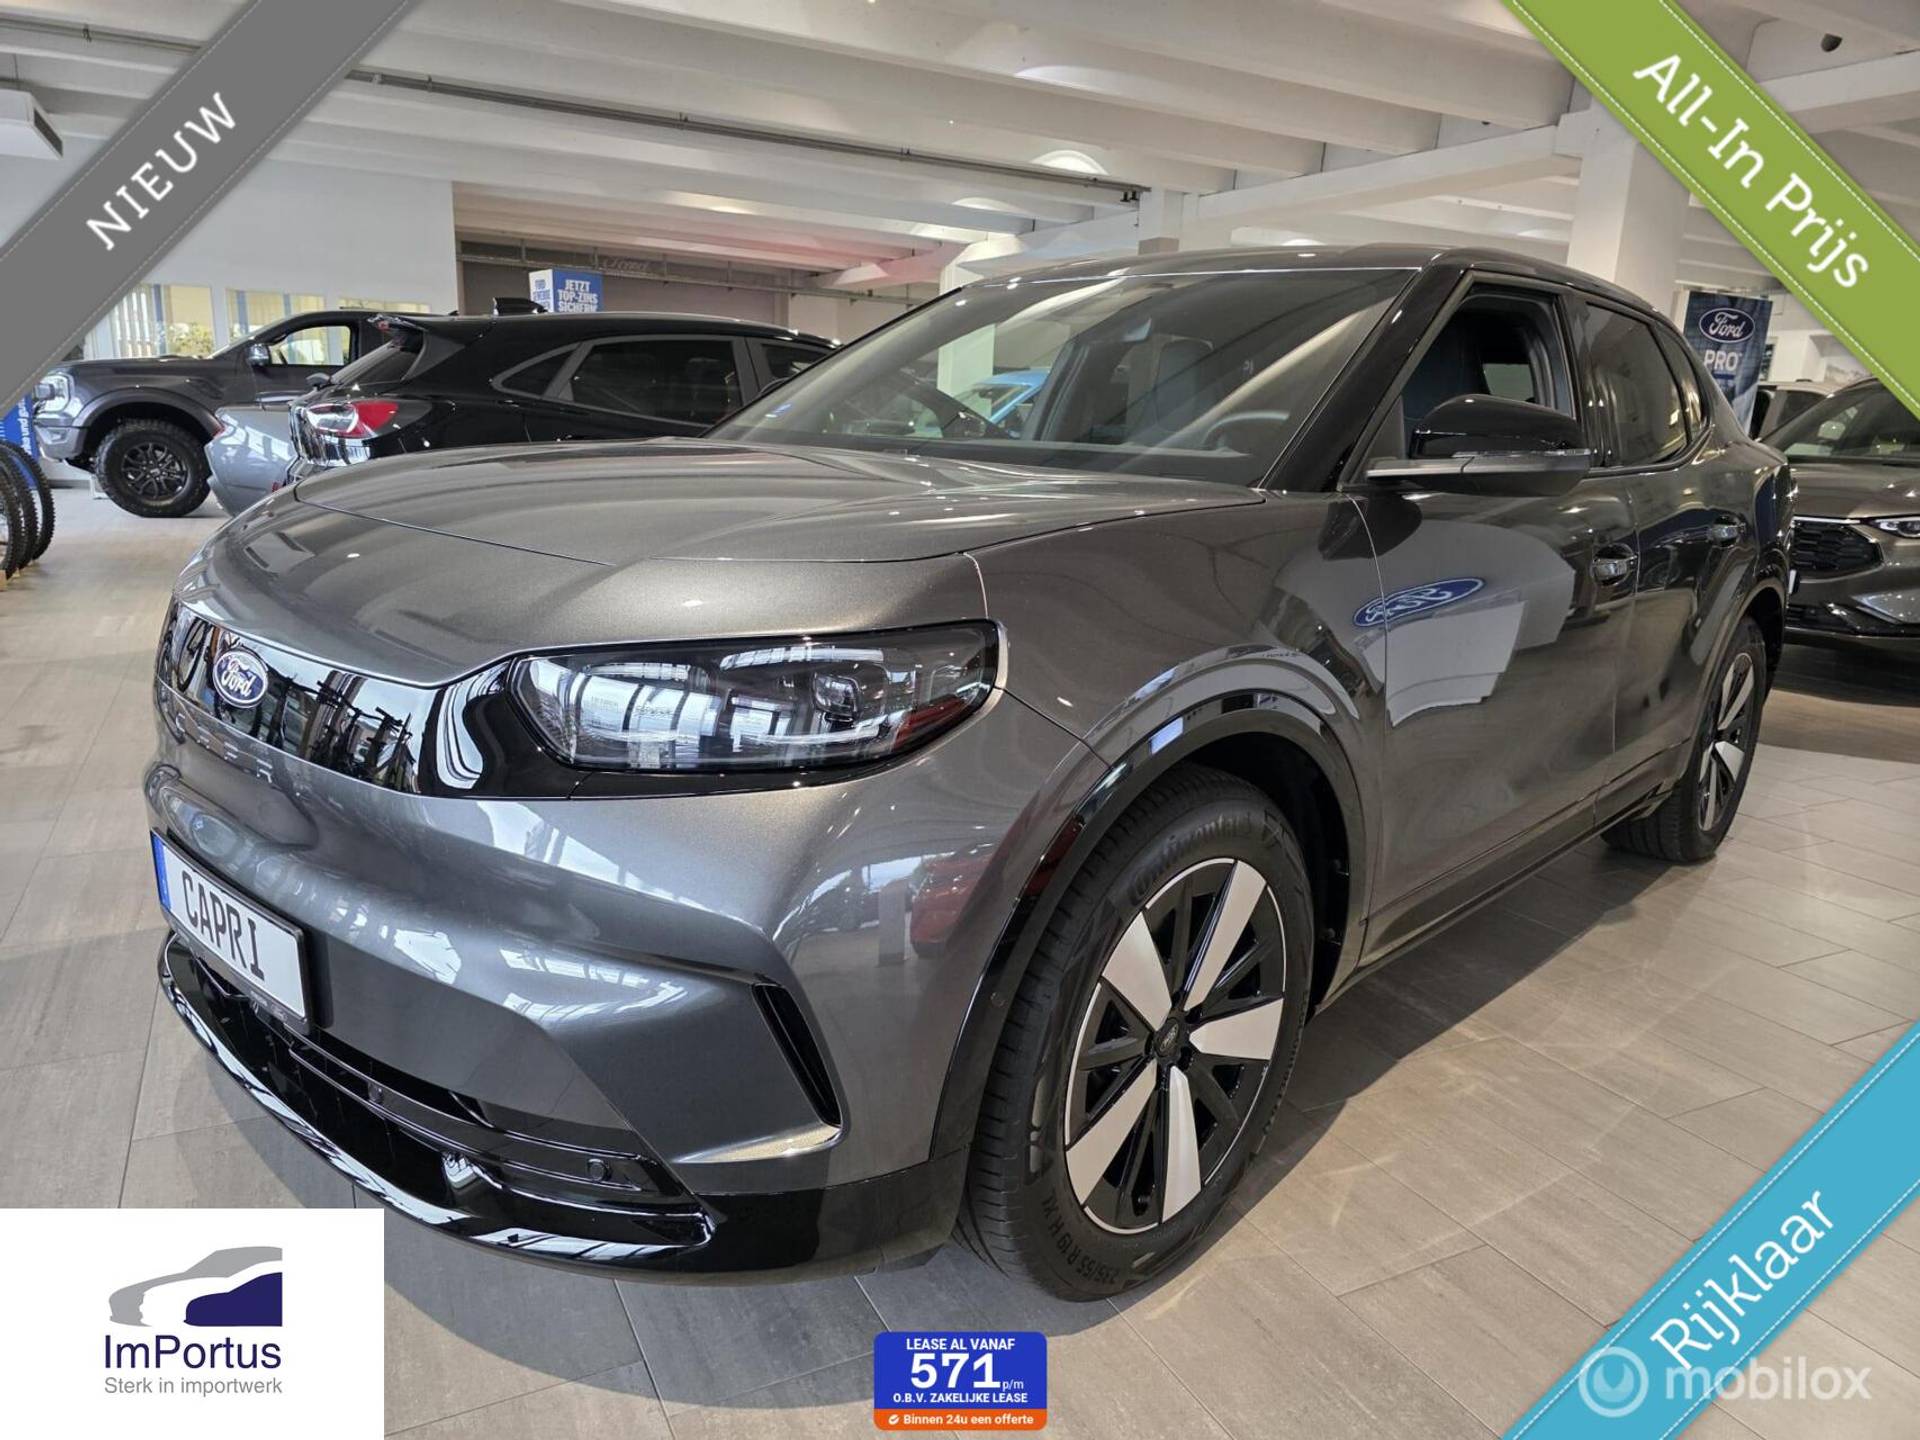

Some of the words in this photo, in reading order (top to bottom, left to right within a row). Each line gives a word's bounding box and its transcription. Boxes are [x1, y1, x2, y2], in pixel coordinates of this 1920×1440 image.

[557, 289, 599, 305] TOP-ZINS
[564, 279, 591, 292] JETZT
[1709, 311, 1746, 338] Ford
[1703, 349, 1738, 371] PRO
[221, 658, 256, 697] Ford
[182, 870, 265, 981] CAPRI
